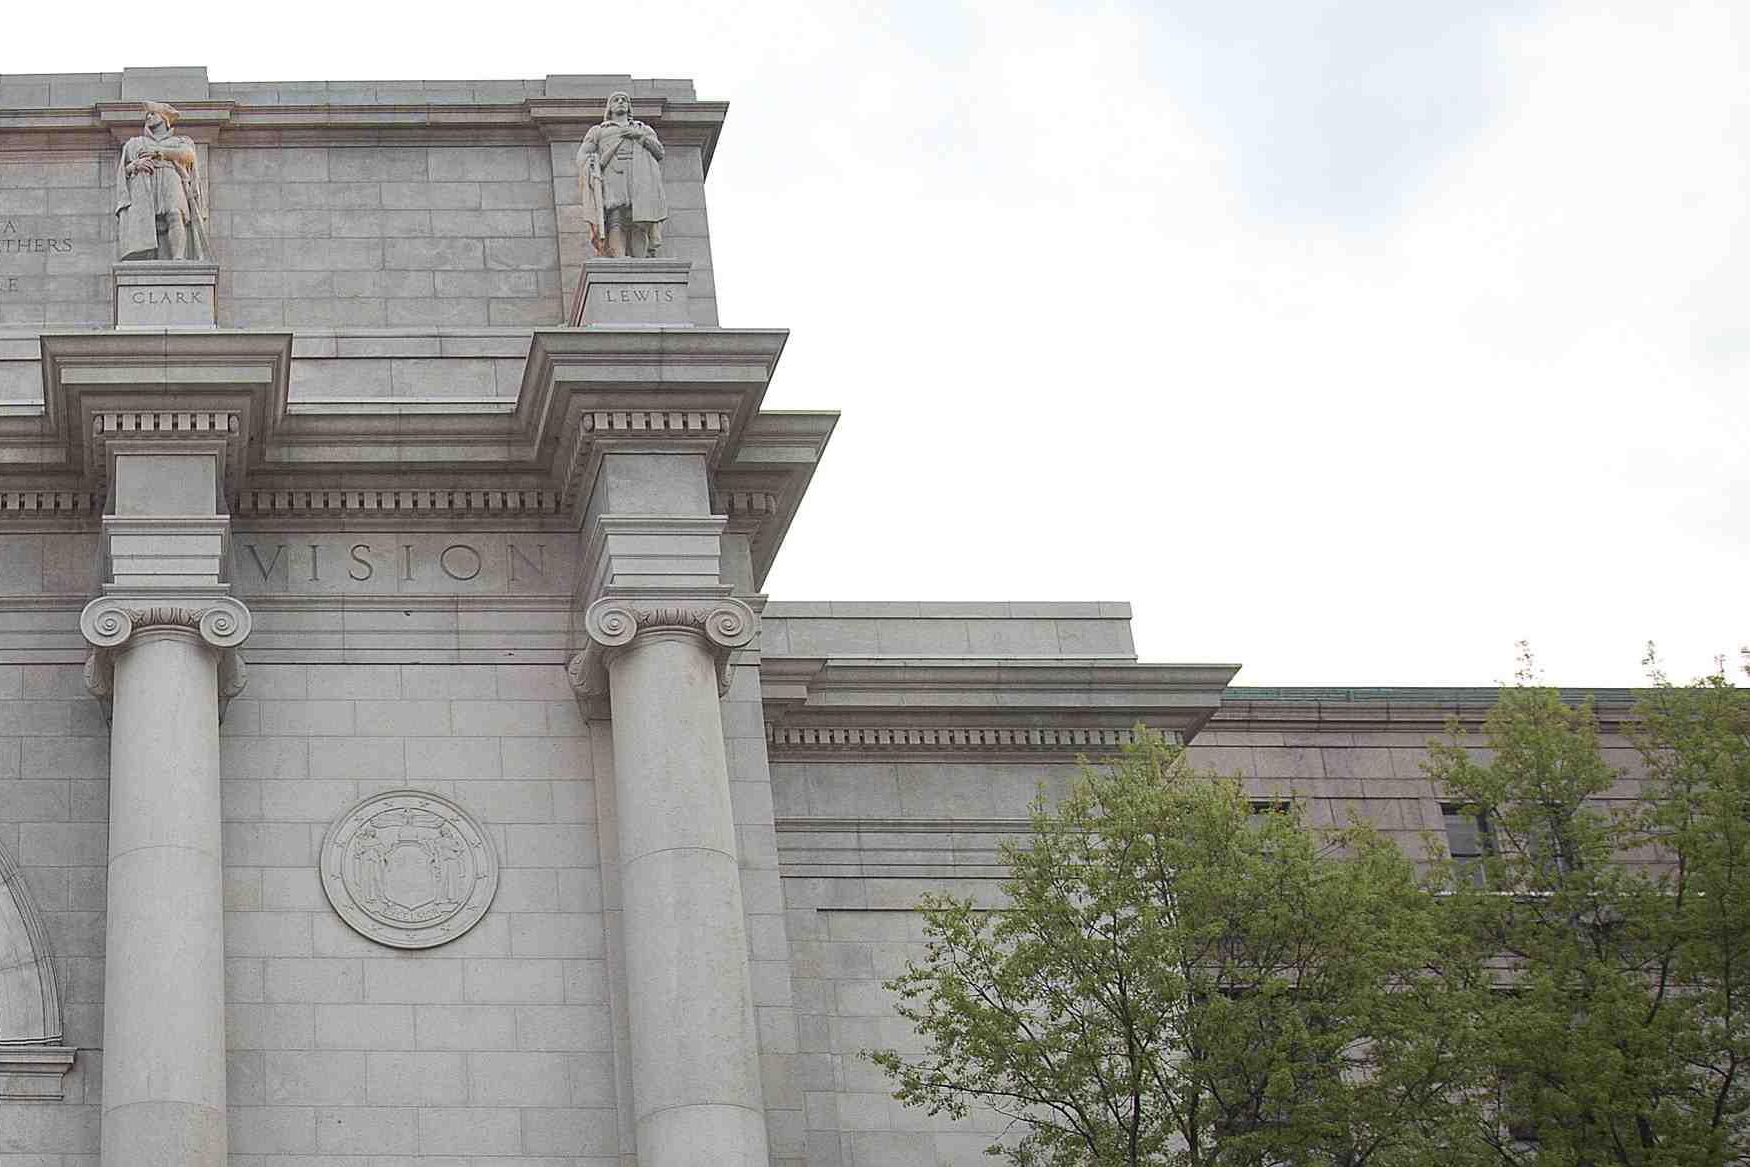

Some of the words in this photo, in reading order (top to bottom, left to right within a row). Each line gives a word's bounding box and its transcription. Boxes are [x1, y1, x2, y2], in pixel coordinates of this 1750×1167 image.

[132, 291, 203, 304] CLARK
[606, 289, 674, 303] LEWIS
[245, 543, 548, 582] VISION
